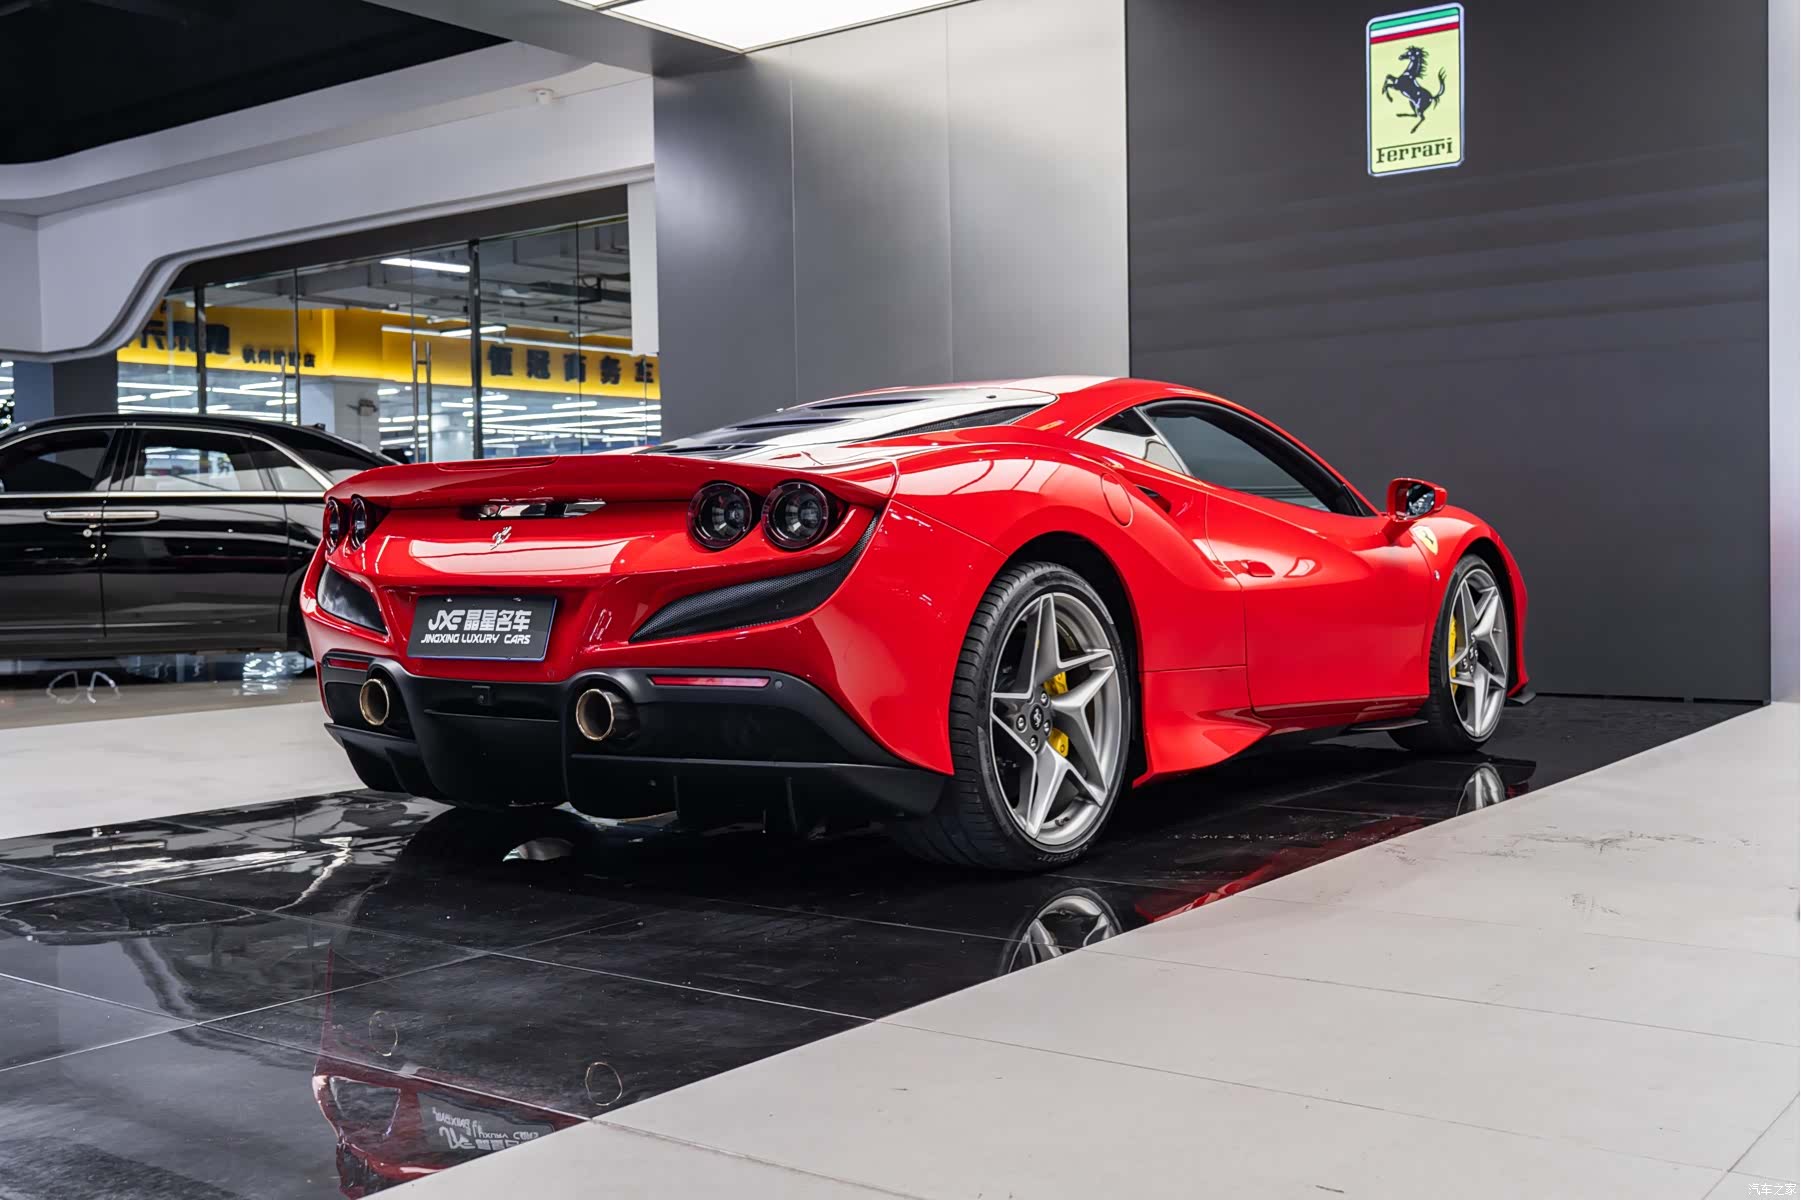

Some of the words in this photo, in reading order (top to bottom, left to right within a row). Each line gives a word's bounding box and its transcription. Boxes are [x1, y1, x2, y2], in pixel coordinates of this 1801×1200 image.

[1376, 137, 1453, 164] Ferrari
[464, 609, 531, 632] 晶星名车
[421, 633, 460, 644] JINGXING
[461, 633, 500, 644] LUXURY
[504, 634, 531, 645] CARS
